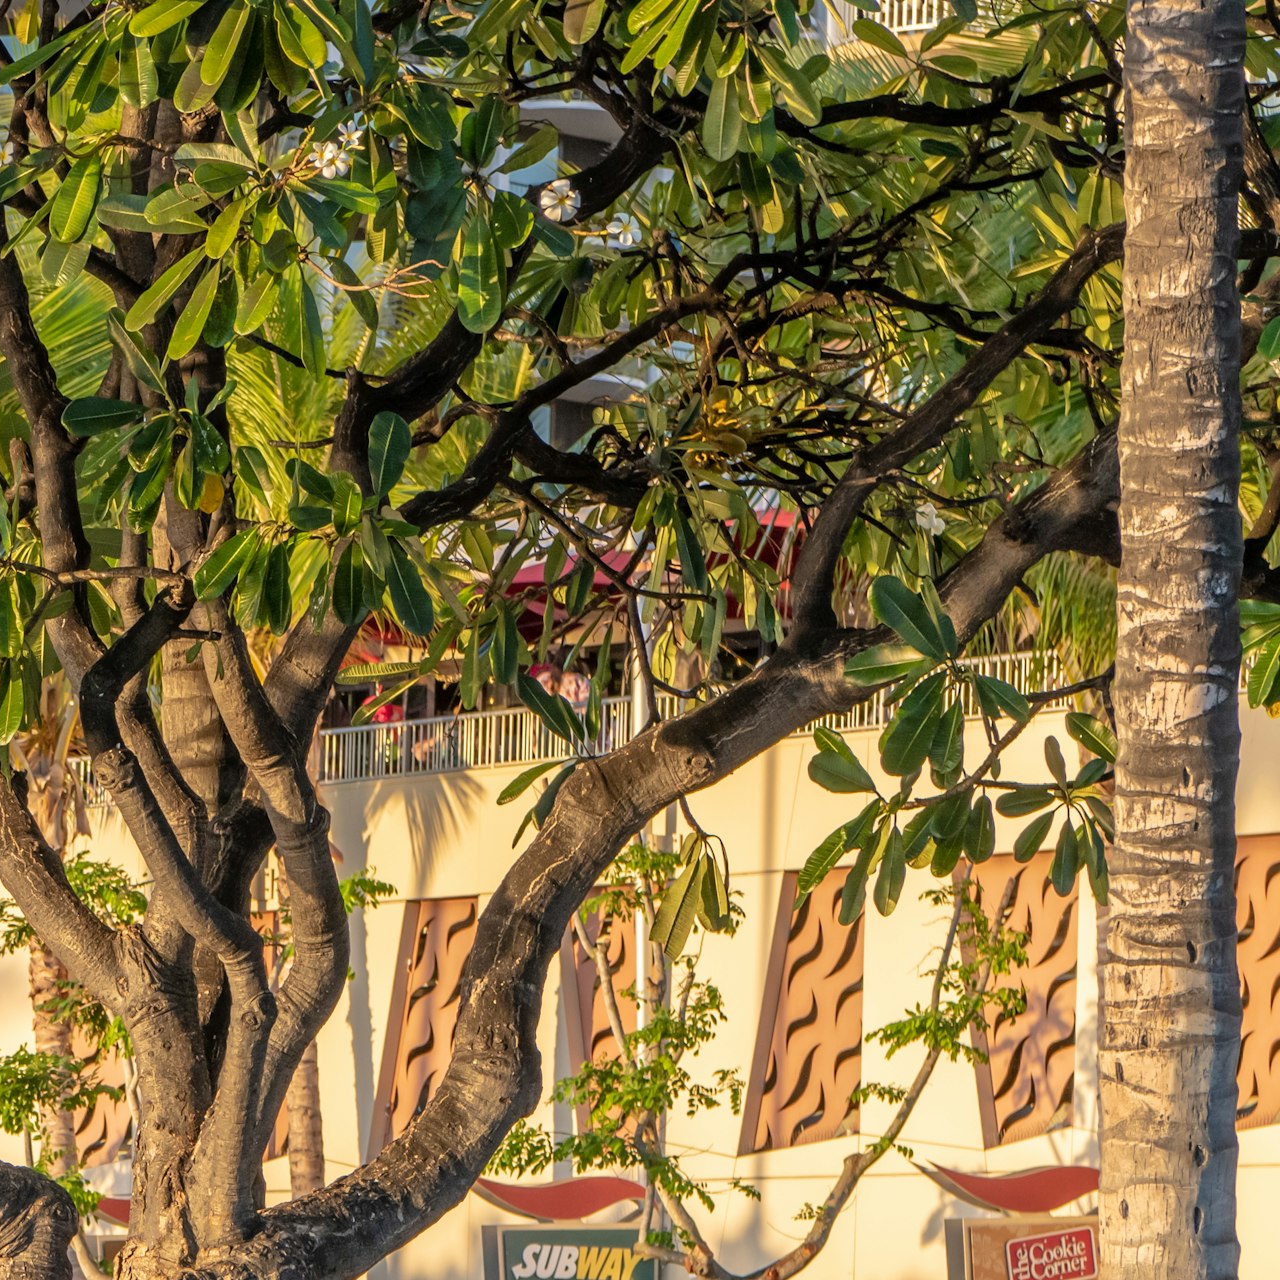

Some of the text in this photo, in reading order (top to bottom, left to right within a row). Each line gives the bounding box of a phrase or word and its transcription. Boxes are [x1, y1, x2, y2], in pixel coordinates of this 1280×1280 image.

[1013, 1247, 1030, 1280] the
[1029, 1236, 1086, 1264] Cookie
[1030, 1256, 1088, 1280] Corner
